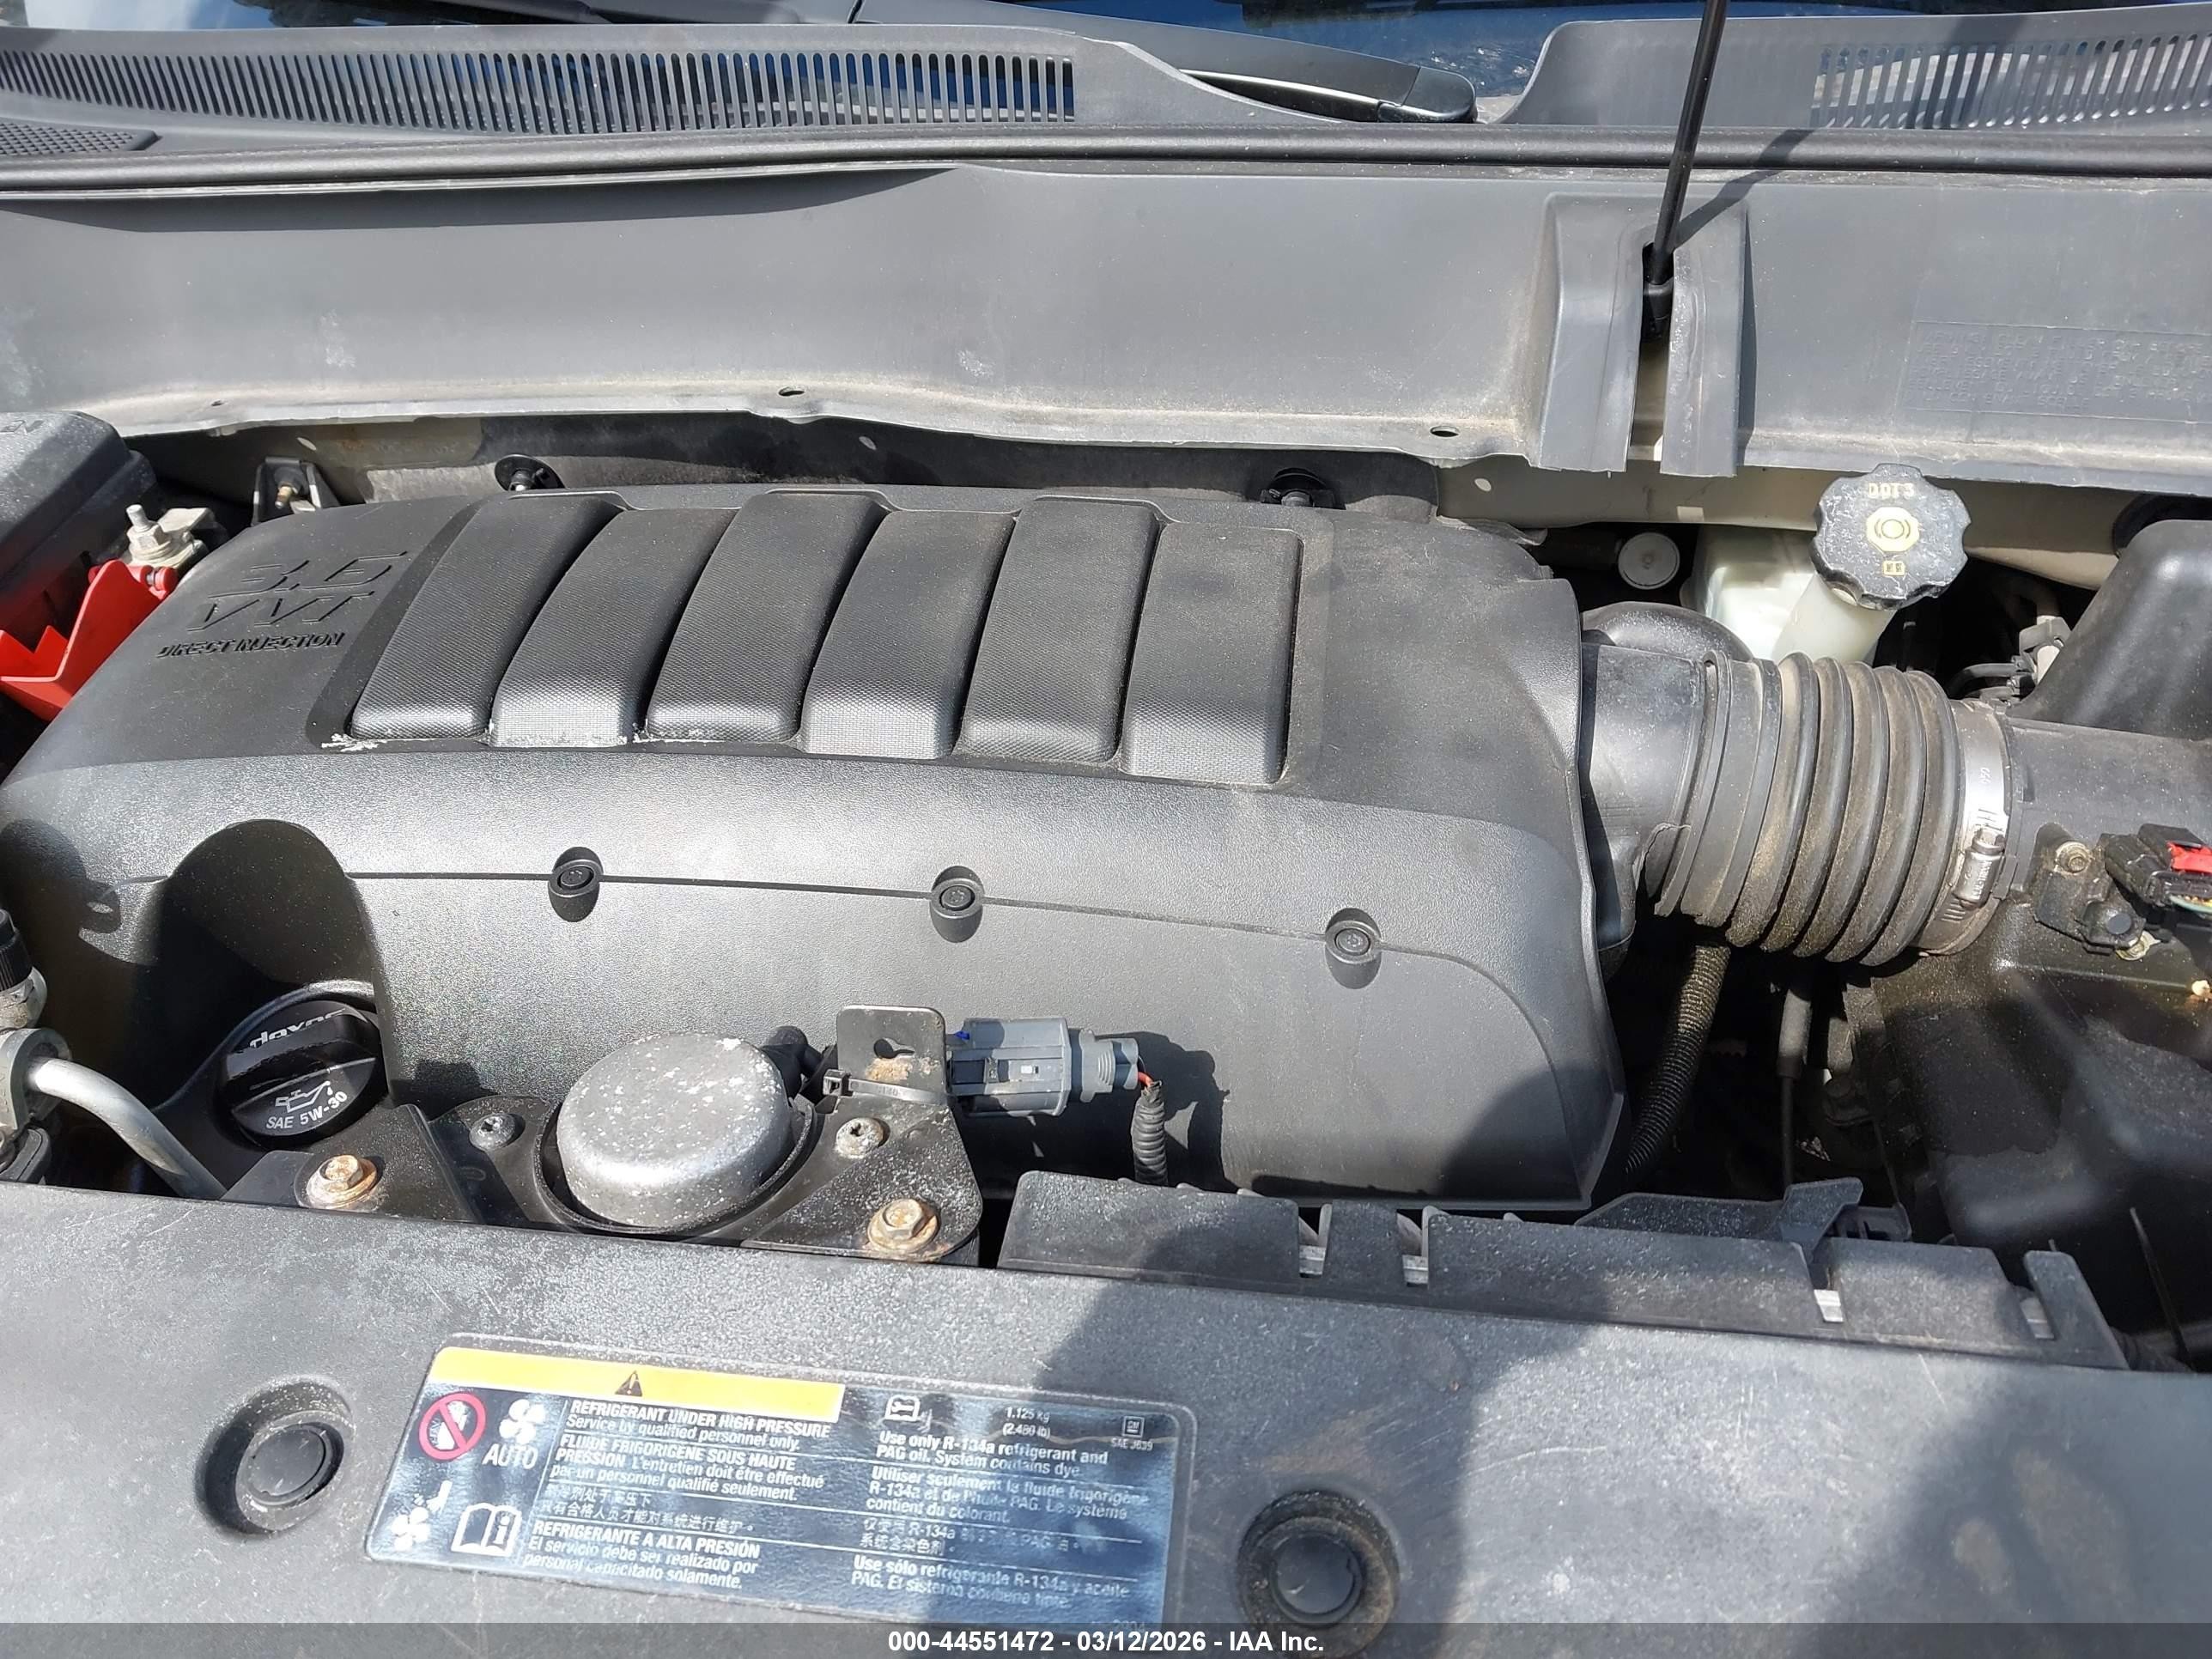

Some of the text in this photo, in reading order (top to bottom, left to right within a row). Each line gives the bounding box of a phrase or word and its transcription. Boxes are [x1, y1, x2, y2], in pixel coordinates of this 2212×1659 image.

[186, 591, 375, 632] VVT
[157, 632, 345, 659] DIRECT INJECTION
[266, 1091, 348, 1130] SAE 5W-30
[566, 1413, 800, 1452] Service by qualified personnel only.
[569, 1399, 831, 1438] REFRIGERANT UNDER HIGH PRESSURE
[482, 1443, 539, 1470] AUTO
[560, 1433, 610, 1450] FLUIDE
[707, 1448, 747, 1466] SOUS
[748, 1452, 797, 1471] HAUTE
[876, 1444, 906, 1461] PAG
[908, 1448, 931, 1463] oil.
[934, 1449, 988, 1468] System
[989, 1457, 1051, 1475] contains
[879, 1430, 1109, 1465] Use only R-134a refrigerant and
[1111, 1437, 1128, 1449] SAE
[575, 1467, 594, 1479] un
[596, 1469, 664, 1486] personnel
[666, 1477, 719, 1493] qualifié
[721, 1481, 798, 1501] seulement.
[706, 1463, 734, 1480] doit
[735, 1466, 763, 1482] être
[766, 1471, 824, 1489] effectué
[872, 1465, 925, 1484] Utiliser
[926, 1473, 1002, 1492] seulement
[1024, 1481, 1065, 1498] fluide
[866, 1498, 1011, 1523] contient du colorant.
[869, 1480, 921, 1499] R-134a
[924, 1487, 939, 1501] et
[1046, 1498, 1065, 1513] Le
[1067, 1503, 1127, 1520] système
[528, 1535, 759, 1576] El servicio debe ser realizado por
[532, 1519, 761, 1559] REFRIGERANTE A ALTA PRESIÓN
[522, 1553, 586, 1572] personal
[665, 1567, 743, 1589] solamente.
[851, 1571, 884, 1589] PAG.
[905, 1577, 964, 1597] sistema
[854, 1554, 884, 1571] Use
[885, 1559, 918, 1577] sólo
[920, 1564, 1011, 1586] refrigerante
[1013, 1572, 1068, 1592] R-134a
[1085, 1583, 1131, 1598] aceite
